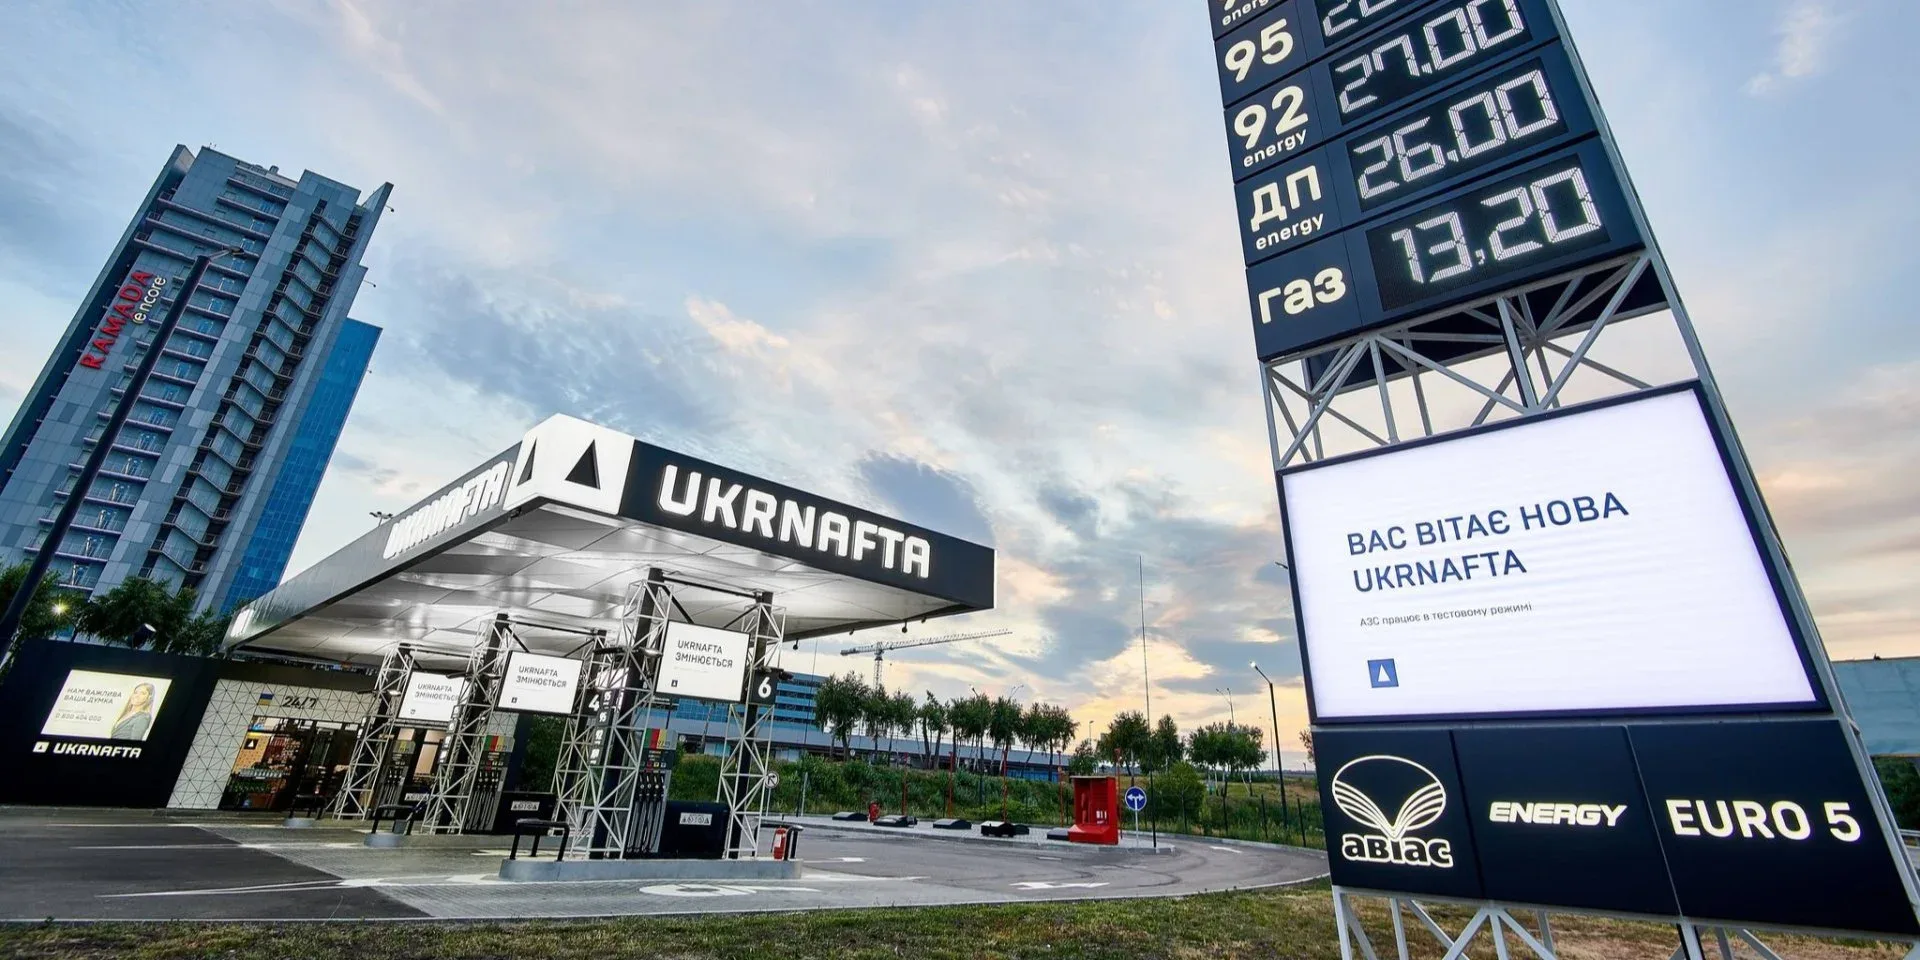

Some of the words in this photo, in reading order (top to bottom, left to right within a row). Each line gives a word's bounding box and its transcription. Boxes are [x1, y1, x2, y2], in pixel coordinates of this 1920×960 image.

[1225, 18, 1294, 83] 95
[1335, 0, 1524, 114] 27.00
[1234, 85, 1308, 150] 92
[1353, 69, 1558, 199] 26.00
[1243, 128, 1307, 168] energy
[1250, 165, 1322, 232] ДП
[1255, 213, 1324, 250] energy
[1258, 267, 1346, 324] газ
[80, 270, 155, 369] RAMADA
[383, 460, 514, 560] UKRNAFTA
[658, 464, 931, 579] UKRNAFTA
[1347, 526, 1408, 556] ВАС
[1415, 510, 1511, 546] ВІТАЄ
[1519, 491, 1630, 531] НОВА
[1353, 549, 1528, 593] UKRNAFTA
[1359, 617, 1380, 627] АЗС
[1382, 611, 1421, 625] працює
[1423, 612, 1430, 621] в
[1432, 606, 1488, 621] тестовому
[1490, 601, 1533, 616] режимі
[675, 652, 733, 669] ЗМІНЮЄТЬСЯ
[678, 640, 723, 655] UKRNAFTA
[417, 683, 452, 693] UKRNAFTA
[515, 675, 567, 688] ЗМІНЮЄТЬСЯ
[518, 666, 559, 677] UKRNAFTA
[758, 676, 771, 698] 6
[282, 695, 318, 709] 24/7
[588, 694, 600, 711] 4
[53, 743, 142, 759] UKRNAFTA
[1489, 801, 1627, 827] ENERGY
[1665, 799, 1811, 841] EURO
[1823, 801, 1861, 842] 5
